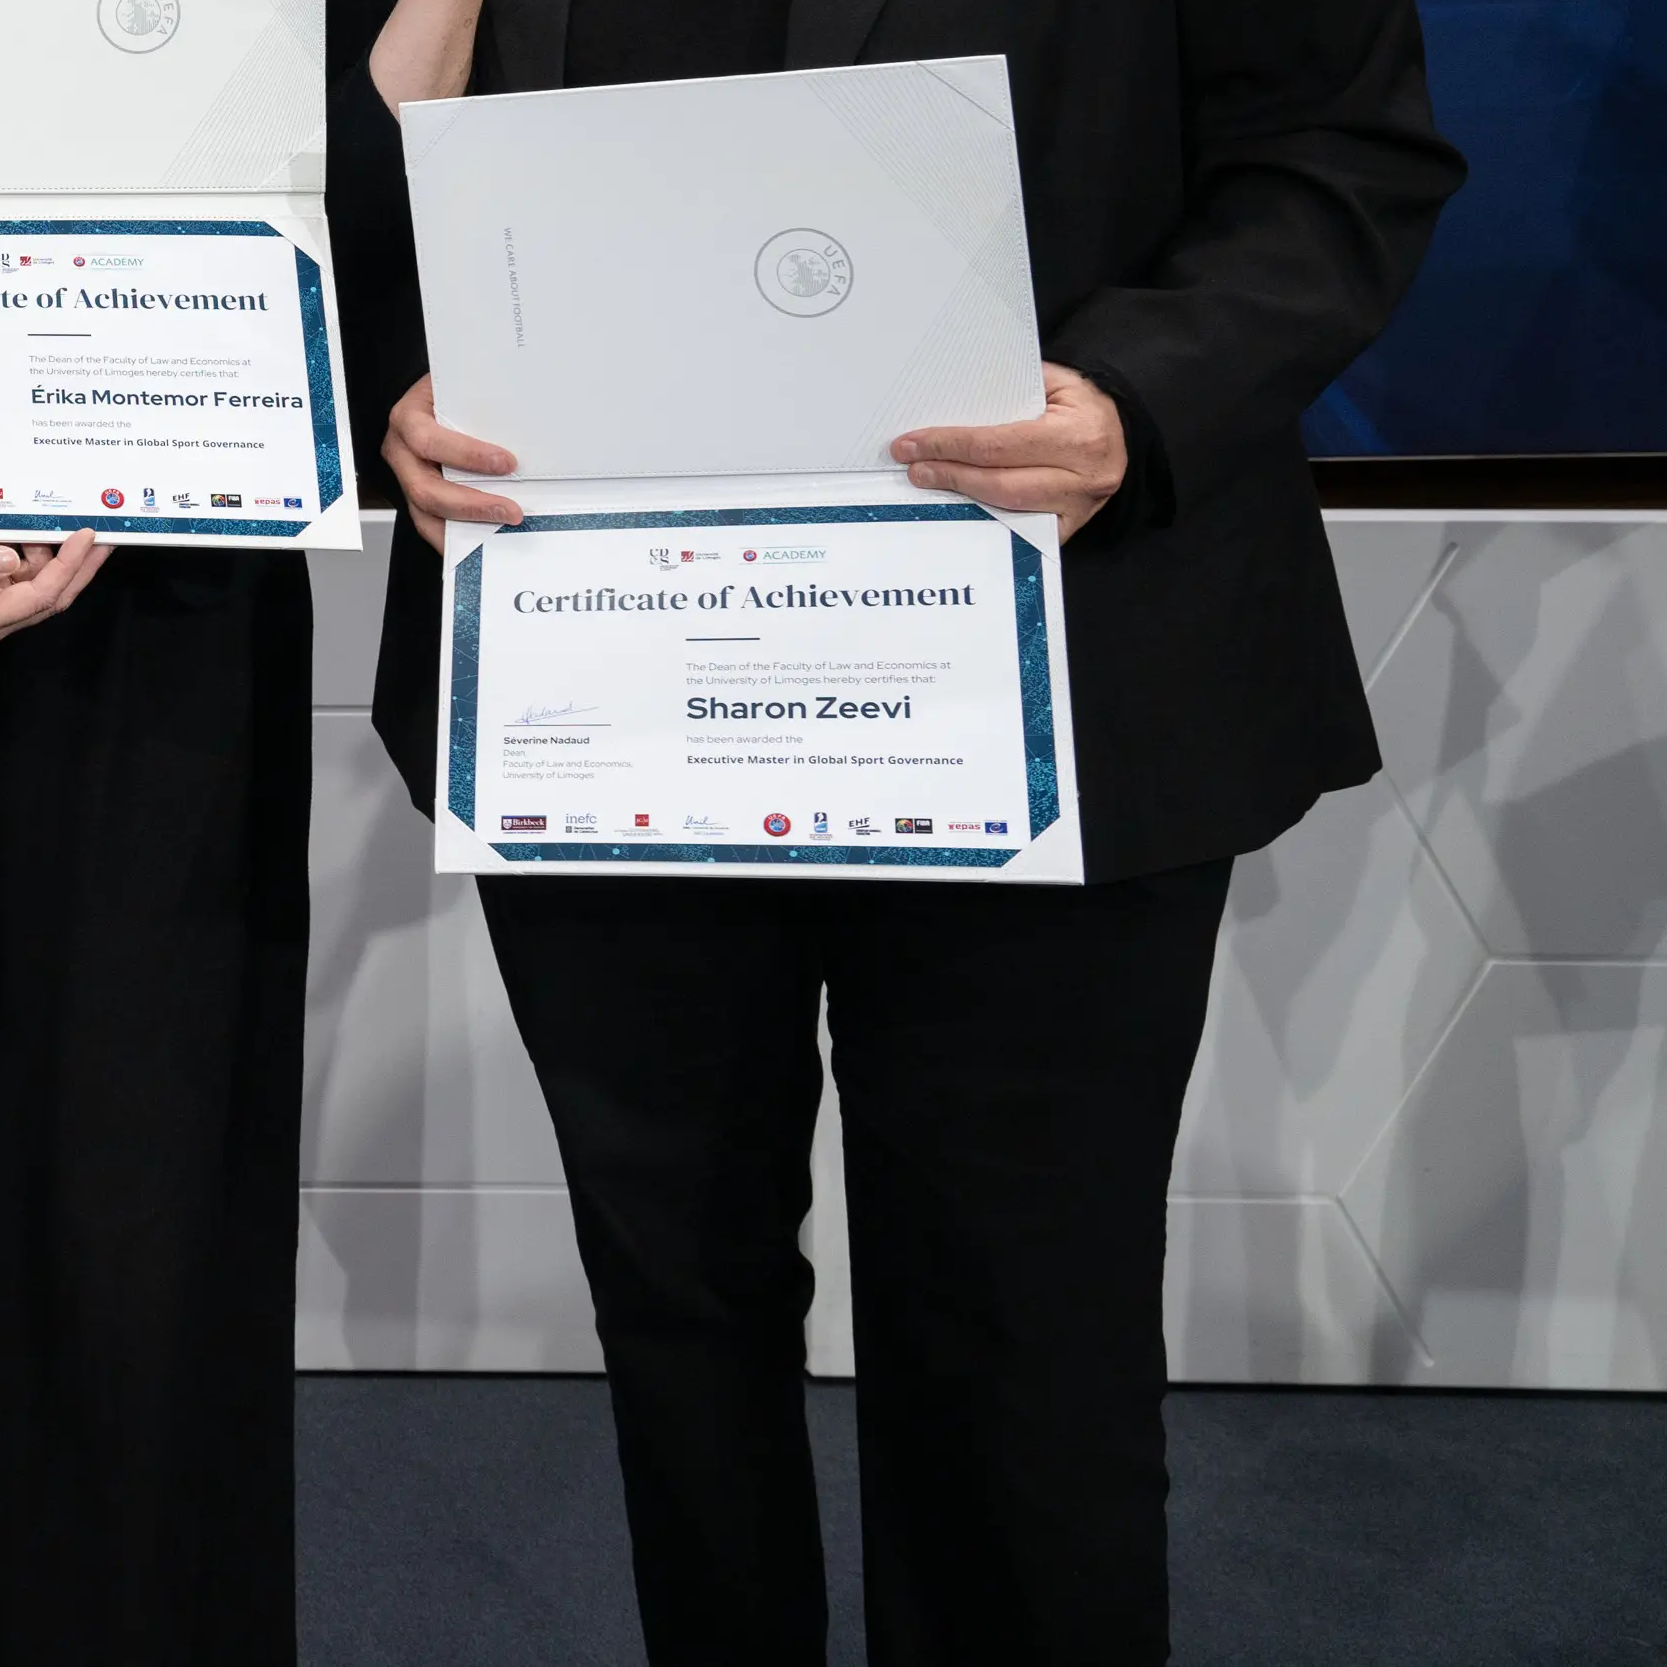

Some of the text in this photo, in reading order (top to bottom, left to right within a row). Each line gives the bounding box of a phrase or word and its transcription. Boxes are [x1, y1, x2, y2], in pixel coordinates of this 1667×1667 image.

[505, 243, 516, 268] CARE
[90, 258, 143, 266] ACADEMY
[823, 244, 846, 296] UEFA
[508, 270, 520, 301] ABOUT
[35, 287, 67, 308] of
[73, 288, 268, 311] Achievement
[512, 303, 525, 348] FOOTBALL
[31, 384, 303, 408] Érika Montemor Ferreira
[31, 419, 131, 428] has been awarded the
[33, 437, 264, 448] Executive Master in Global Sport Governance
[762, 549, 826, 559] ACADEMY
[513, 583, 974, 613] Certificate of Achievement
[686, 695, 910, 719] Sharon Zeevi
[503, 736, 589, 744] Séverine Nadaud
[686, 734, 803, 744] has been awarded the
[687, 755, 963, 766] Executive Master in Global Sport Governance
[511, 818, 544, 826] Birkbeck
[565, 812, 597, 824] inefc
